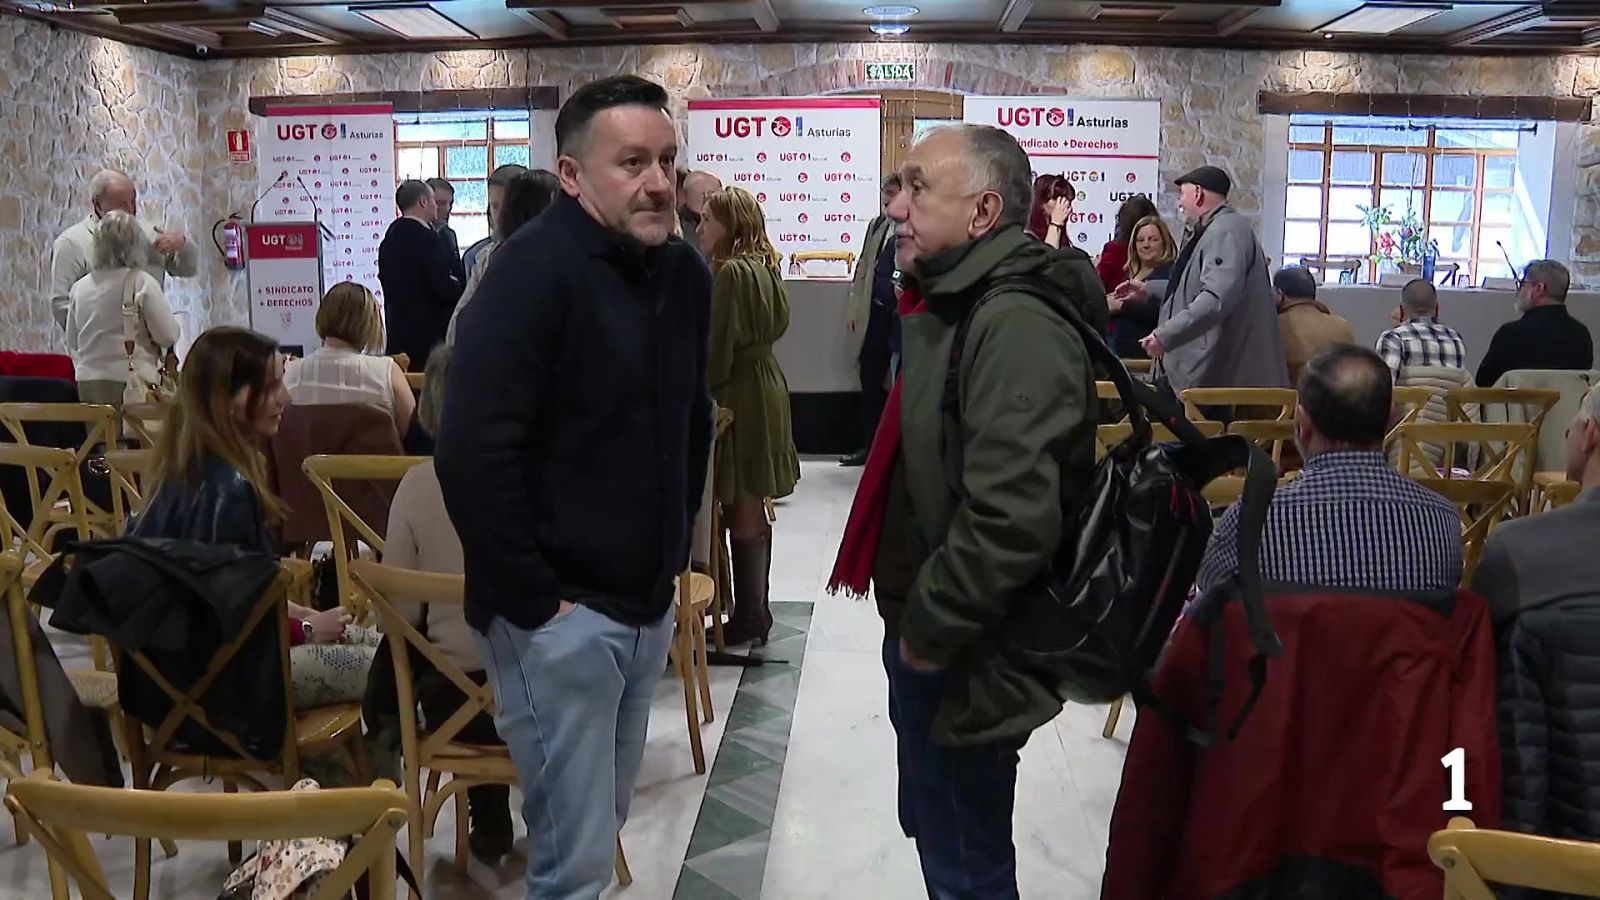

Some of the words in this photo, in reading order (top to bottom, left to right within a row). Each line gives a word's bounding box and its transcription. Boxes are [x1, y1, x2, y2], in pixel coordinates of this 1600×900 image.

[997, 107, 1045, 126] UGT
[1076, 116, 1129, 128] Asturias
[277, 124, 318, 140] UGT
[349, 131, 384, 139] Asturias
[715, 117, 766, 138] UGT
[807, 127, 851, 137] Asturias
[1017, 138, 1059, 148] indicato
[1069, 213, 1086, 223] GT
[261, 234, 287, 246] UGT
[265, 286, 314, 294] SINDICATO
[267, 299, 313, 307] DERECHOS
